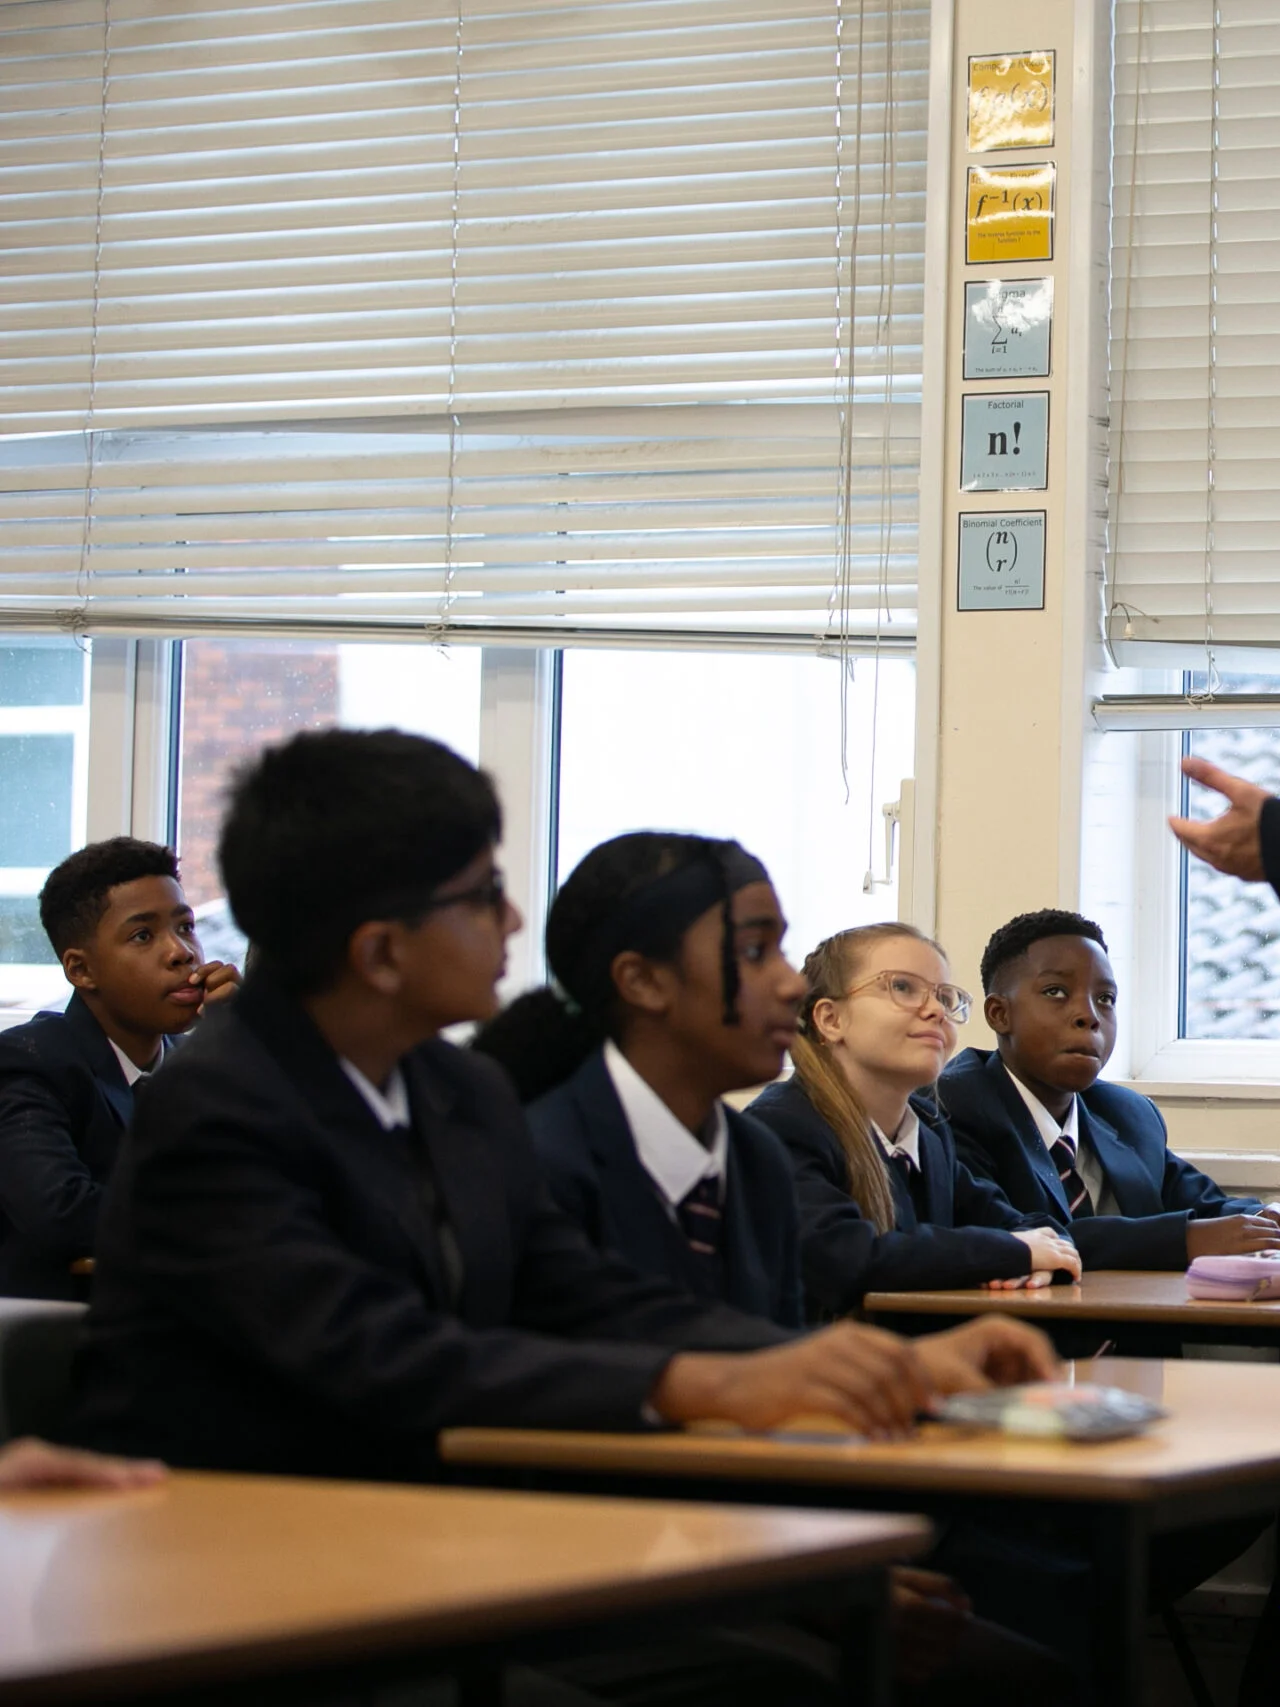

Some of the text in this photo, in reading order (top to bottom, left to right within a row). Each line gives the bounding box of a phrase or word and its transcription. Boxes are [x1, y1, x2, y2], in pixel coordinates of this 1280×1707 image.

[987, 400, 1025, 410] Factorial
[987, 421, 1022, 456] n!
[962, 518, 1043, 529] Binomial Coefficient
